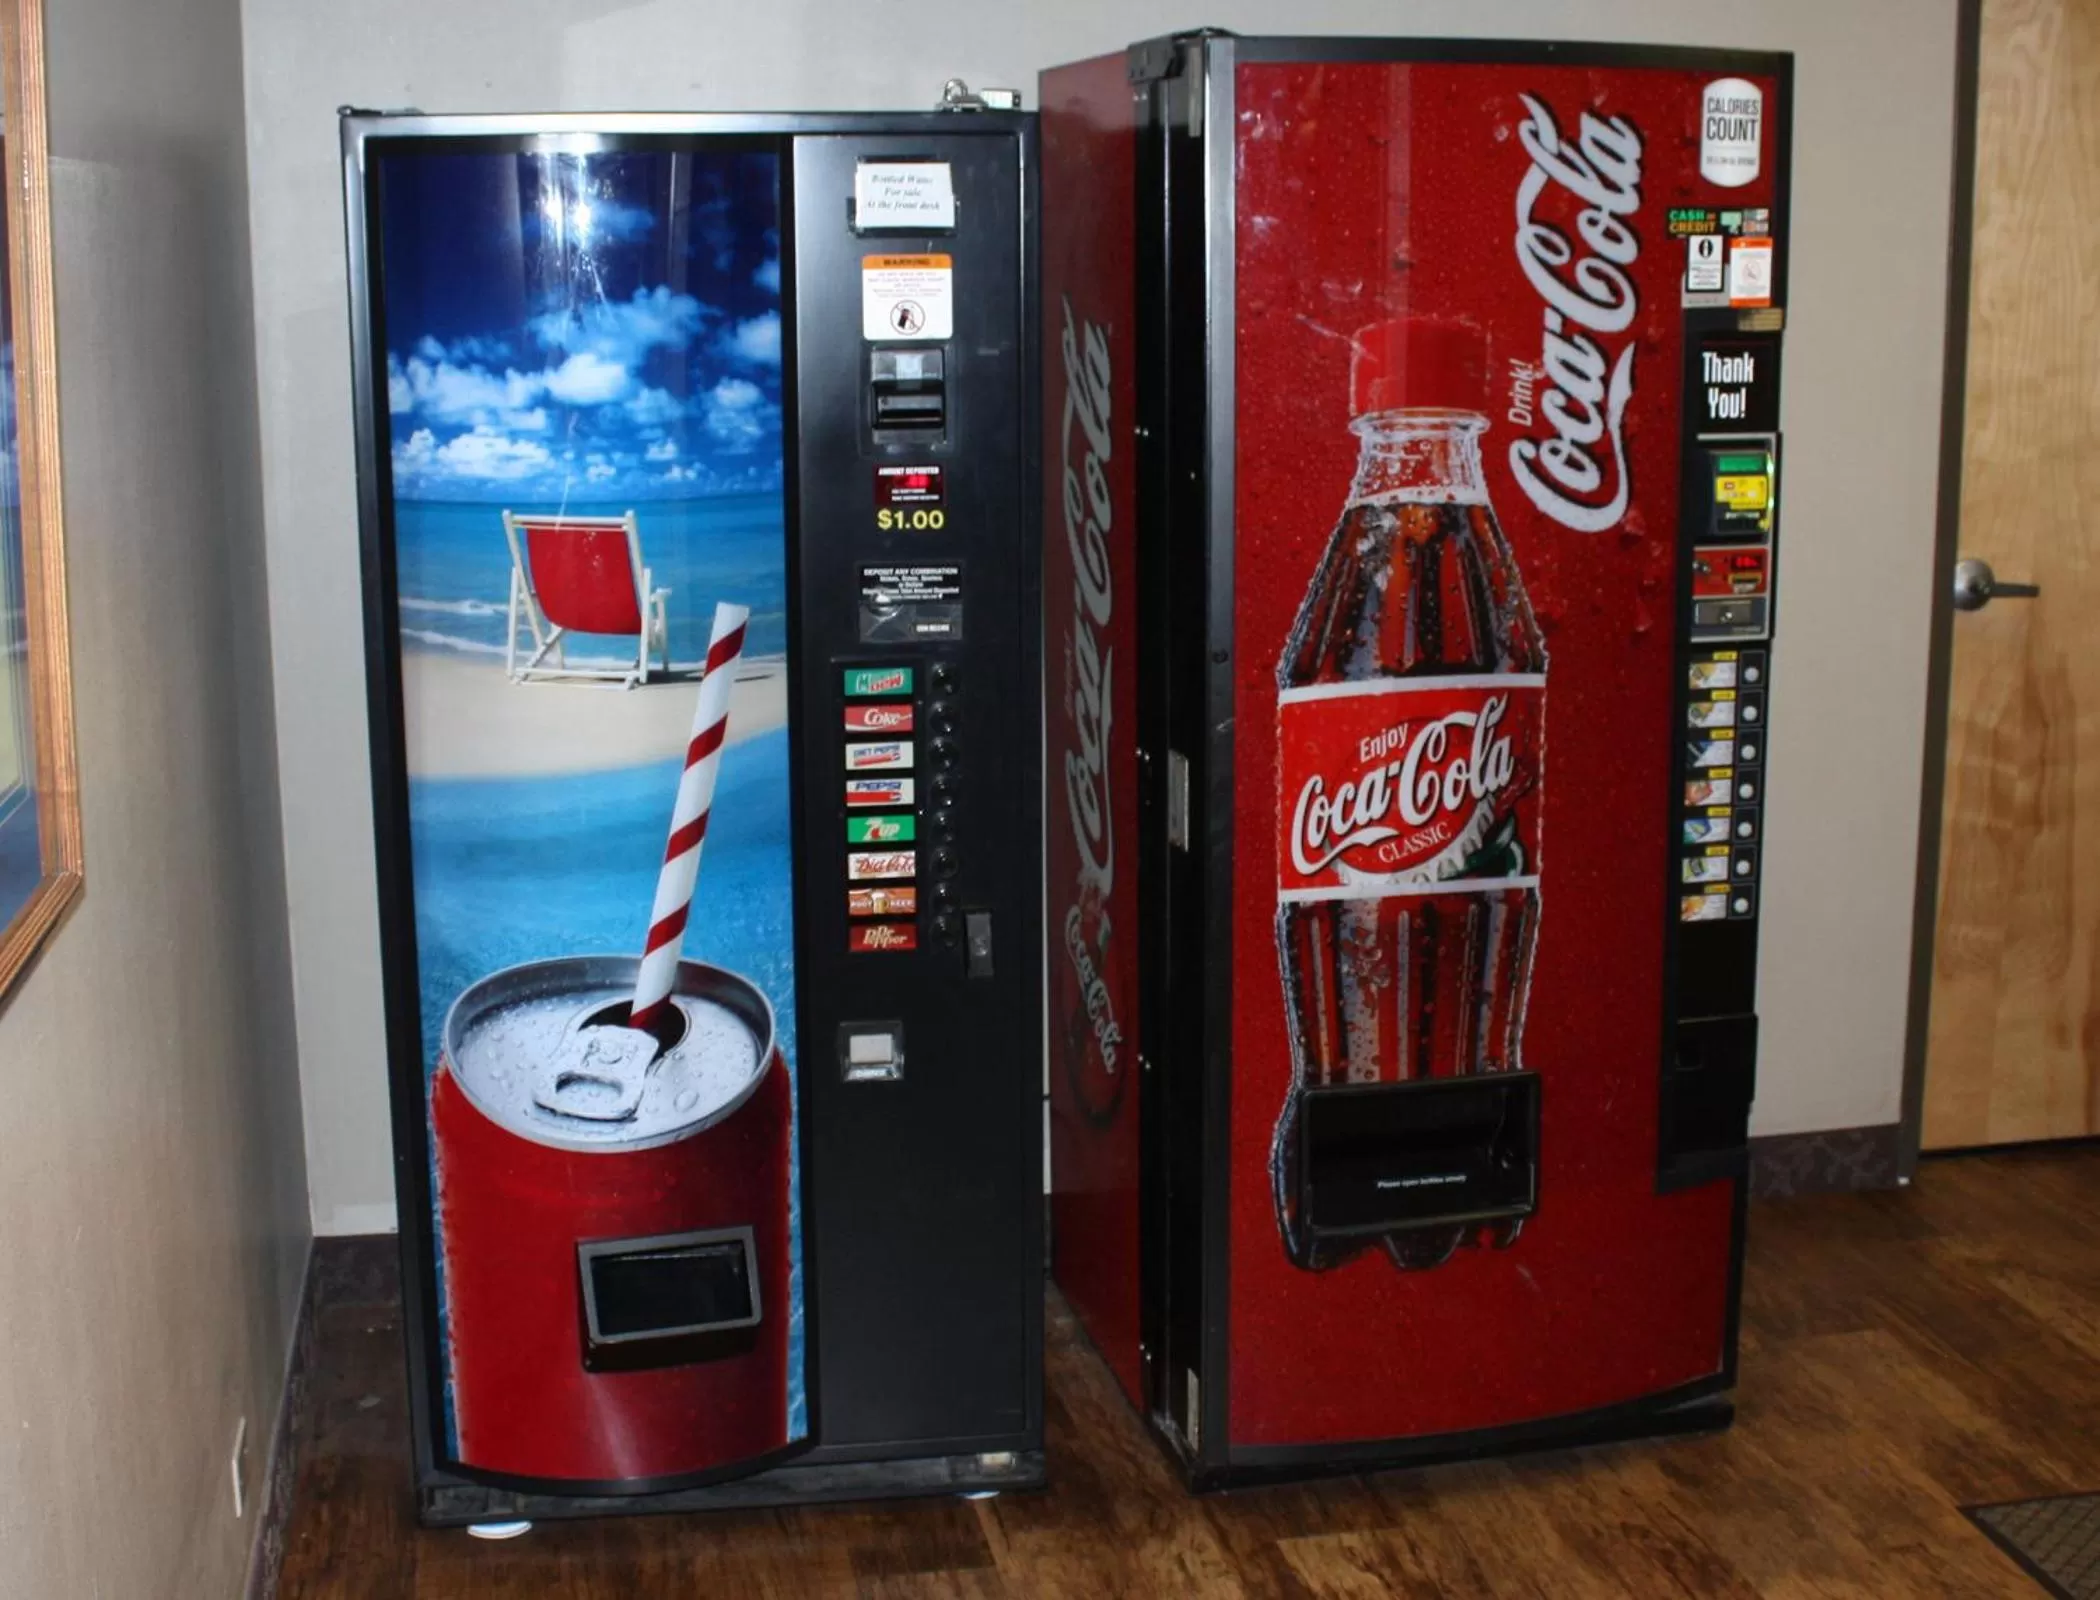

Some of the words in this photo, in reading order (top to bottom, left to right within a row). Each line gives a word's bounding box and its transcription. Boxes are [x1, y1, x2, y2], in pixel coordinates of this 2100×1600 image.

[1707, 97, 1760, 114] CALORIES
[1707, 116, 1758, 141] COUNT
[1669, 208, 1705, 221] CASH
[1669, 221, 1717, 235] CREDIT
[1510, 92, 1642, 532] Coca-Cola
[1702, 351, 1754, 383] Thank
[1508, 358, 1533, 426] Drink!
[1708, 386, 1747, 419] You!
[878, 508, 944, 530] $1.00
[1061, 294, 1113, 897] Coca-Cola
[864, 708, 899, 726] Coke
[1359, 722, 1409, 763] Enjoy
[855, 781, 903, 791] PEPSI
[1290, 692, 1514, 875] Coca-Cola
[1378, 821, 1452, 864] CLASSIC
